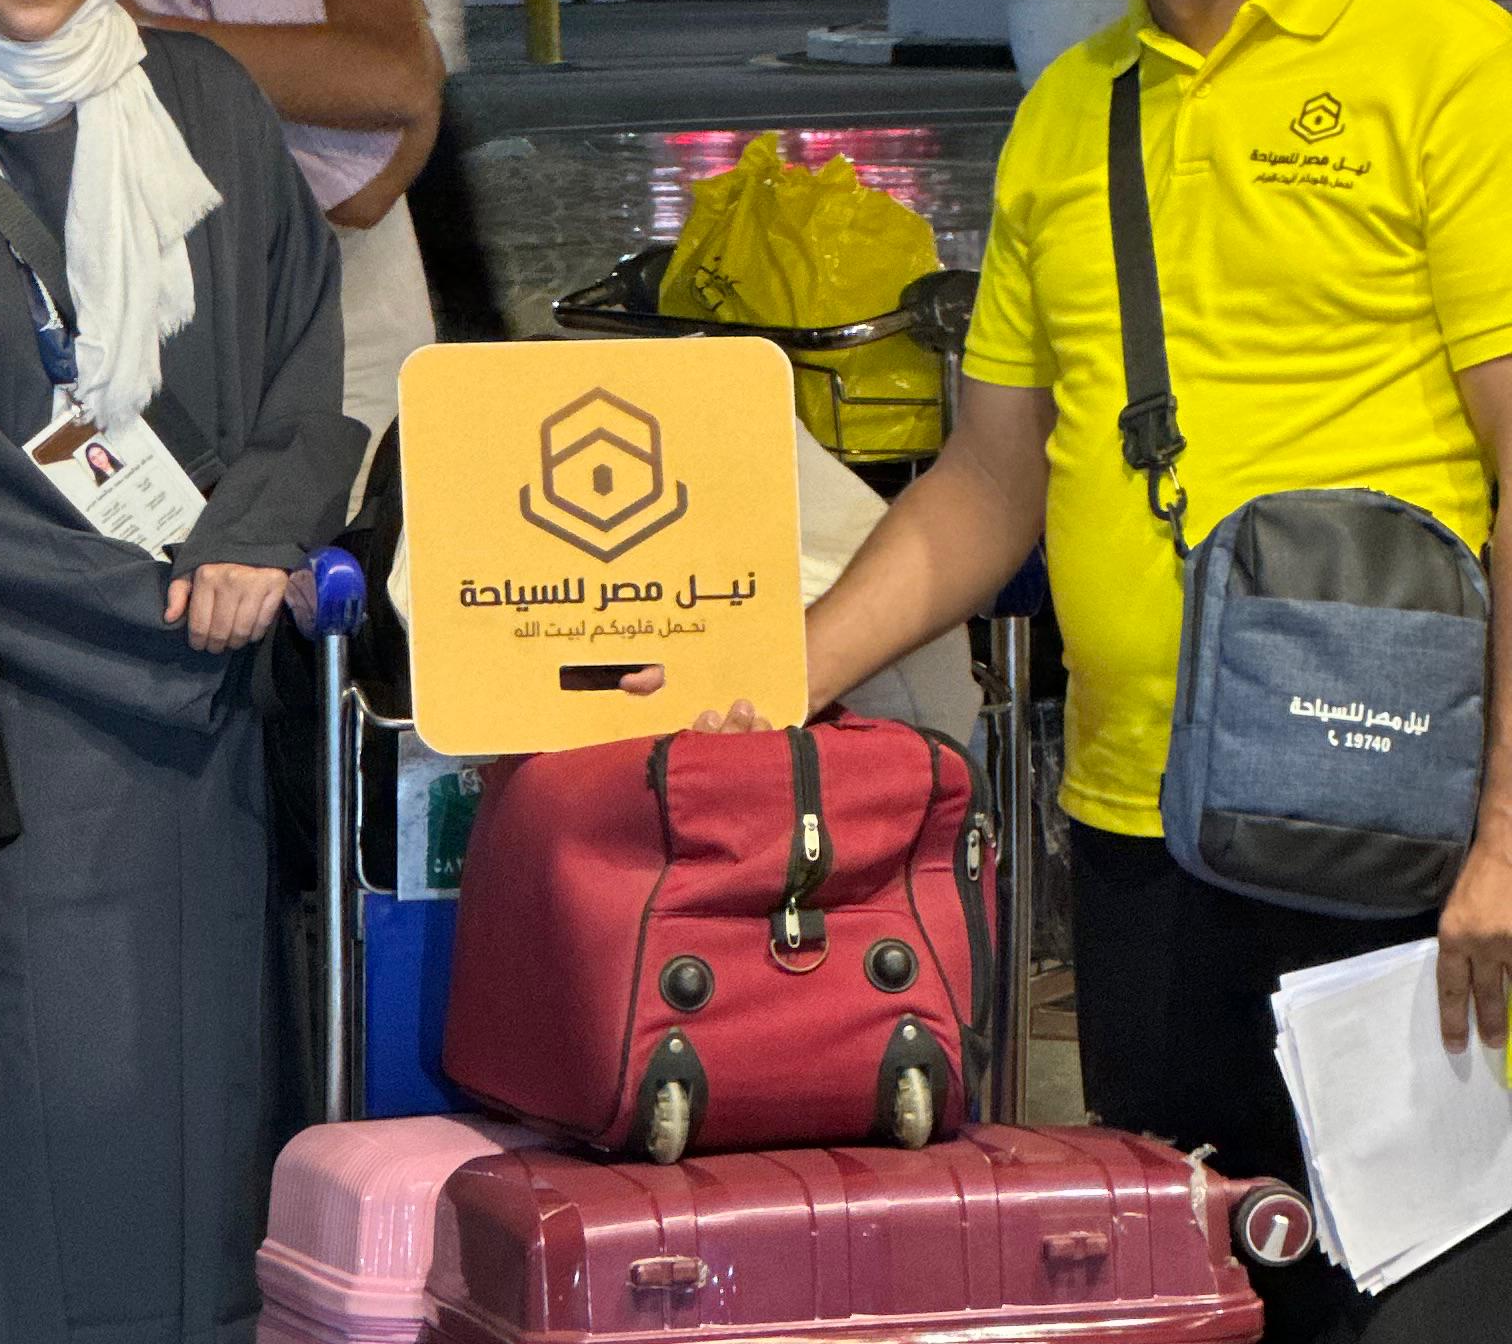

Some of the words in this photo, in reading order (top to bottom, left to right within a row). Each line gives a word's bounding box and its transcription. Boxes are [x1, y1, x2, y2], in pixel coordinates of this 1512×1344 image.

[459, 575, 586, 613] للسياحة
[593, 579, 663, 612] مصر
[675, 571, 757, 609] نيل
[513, 620, 540, 639] الله
[544, 619, 586, 640] لبيت
[589, 618, 654, 643] قلوبكم
[1289, 695, 1364, 723] للسياحة
[1365, 706, 1402, 730] مصر
[1344, 731, 1392, 753] 19740
